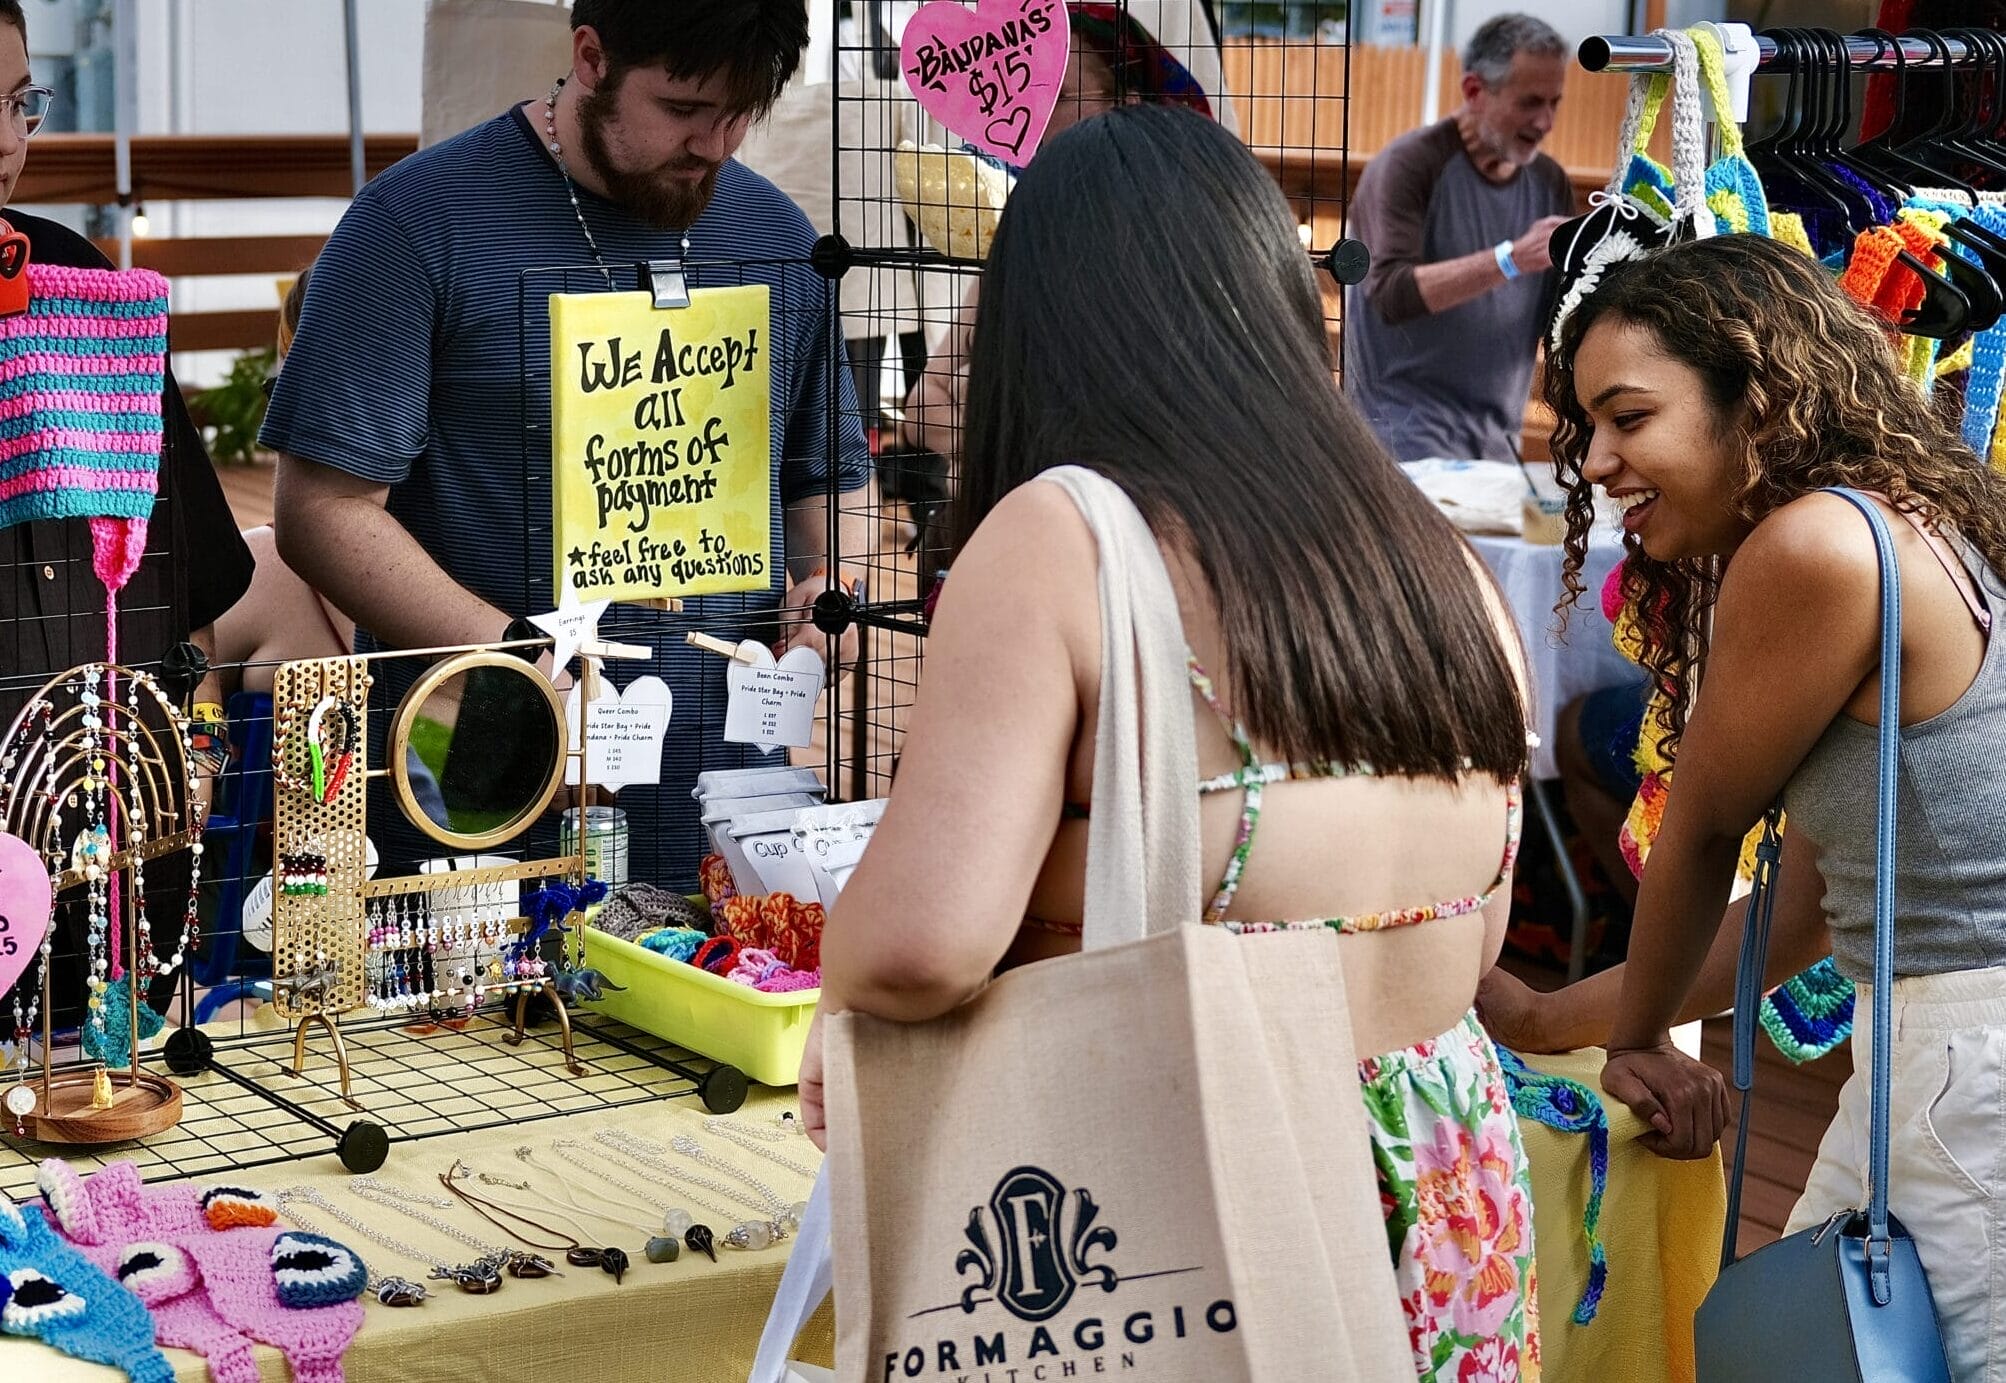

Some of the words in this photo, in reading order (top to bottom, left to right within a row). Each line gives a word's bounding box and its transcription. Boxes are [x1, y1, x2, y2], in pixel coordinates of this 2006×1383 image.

[968, 51, 1031, 117] $15
[651, 328, 758, 389] Accept
[634, 388, 686, 431] all
[584, 434, 679, 484] forms
[687, 417, 729, 466] of
[596, 469, 717, 532] payment
[588, 539, 633, 567] feel
[638, 536, 686, 563] free
[699, 529, 726, 553] to
[572, 559, 615, 588] ask
[623, 561, 662, 587] any
[671, 549, 764, 585] questions
[741, 684, 756, 692] Pride
[772, 687, 783, 698] Bag
[790, 690, 806, 698] Pride
[773, 673, 794, 682] Combo
[597, 707, 615, 715] Queer
[617, 706, 639, 715] Combo
[761, 698, 782, 707] Charm
[601, 722, 614, 730] Star
[616, 722, 628, 732] Bag
[634, 722, 651, 730] Pride
[614, 733, 630, 741] Pride
[632, 733, 653, 741] Charm
[753, 840, 788, 859] Cup
[884, 1299, 1238, 1383] FORMAGGIO
